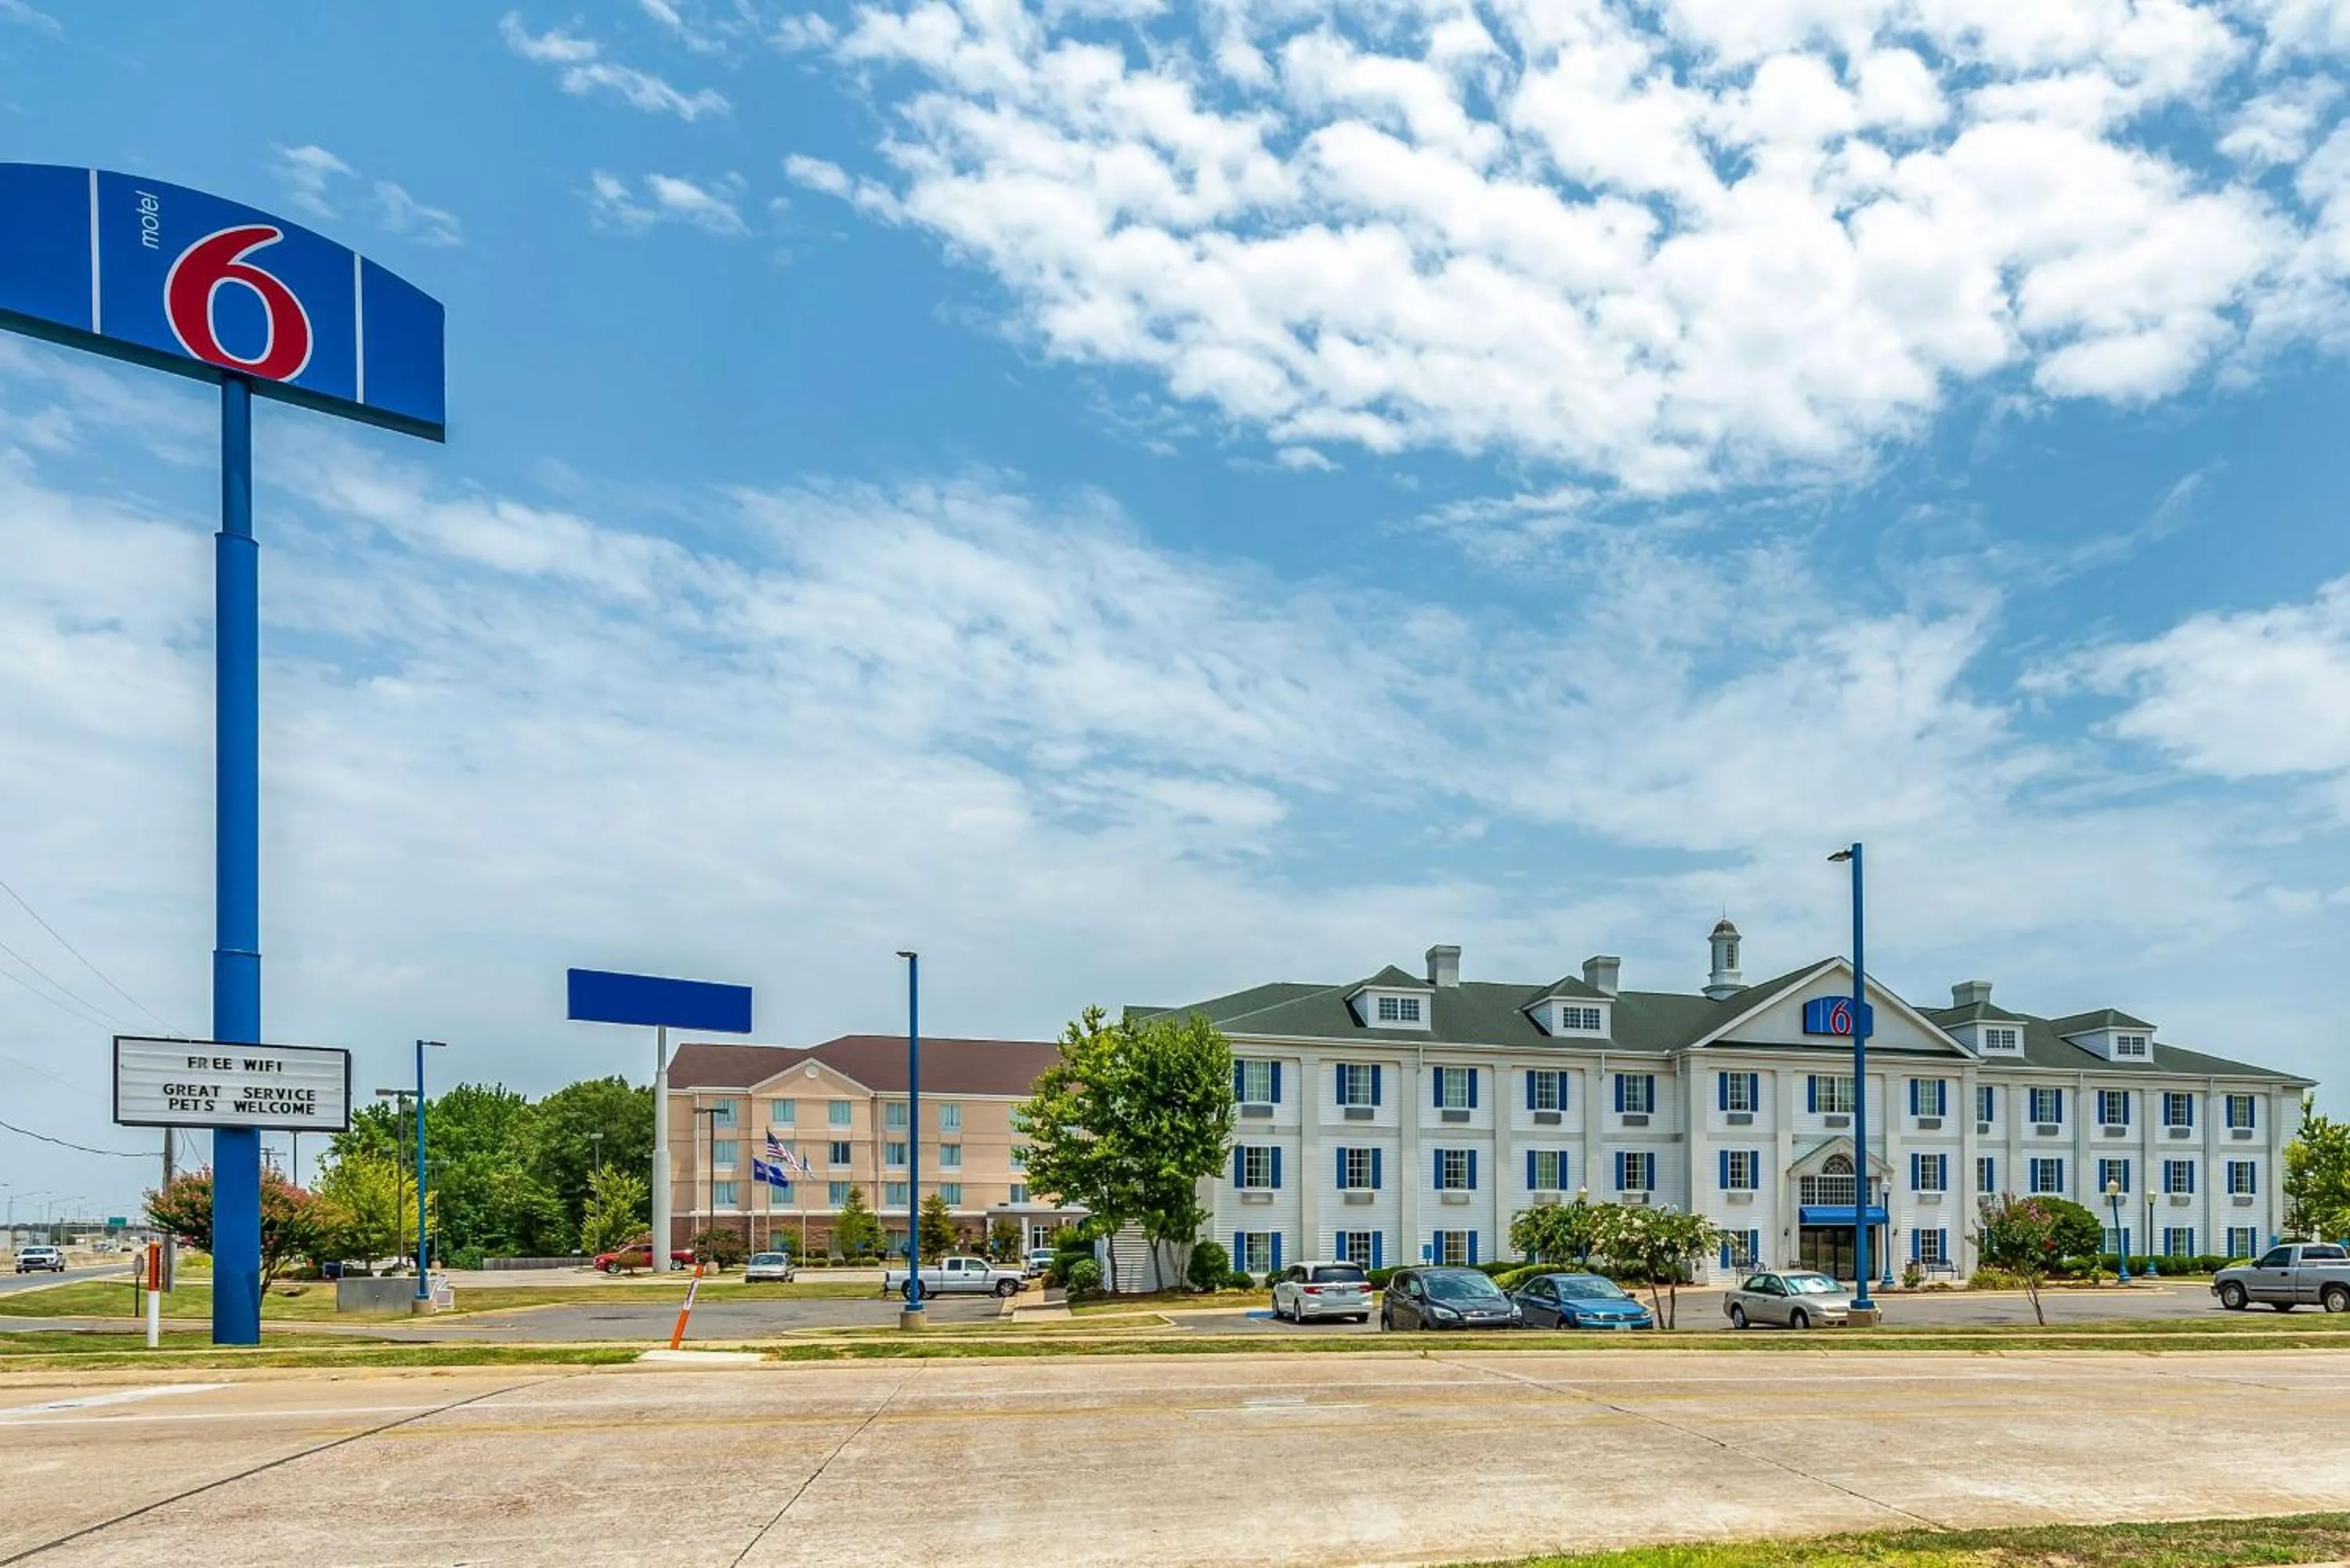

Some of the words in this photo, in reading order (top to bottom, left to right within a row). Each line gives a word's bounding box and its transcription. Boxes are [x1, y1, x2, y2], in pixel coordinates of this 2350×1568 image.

[135, 190, 160, 250] motel
[164, 224, 313, 382] 6
[1830, 999, 1853, 1035] 6
[187, 1056, 233, 1071] FREE
[244, 1058, 283, 1072] WIFI
[162, 1083, 222, 1098] GREAT
[243, 1086, 316, 1101] SERVICE
[168, 1097, 215, 1111] PETS
[233, 1100, 316, 1115] WELCOME
